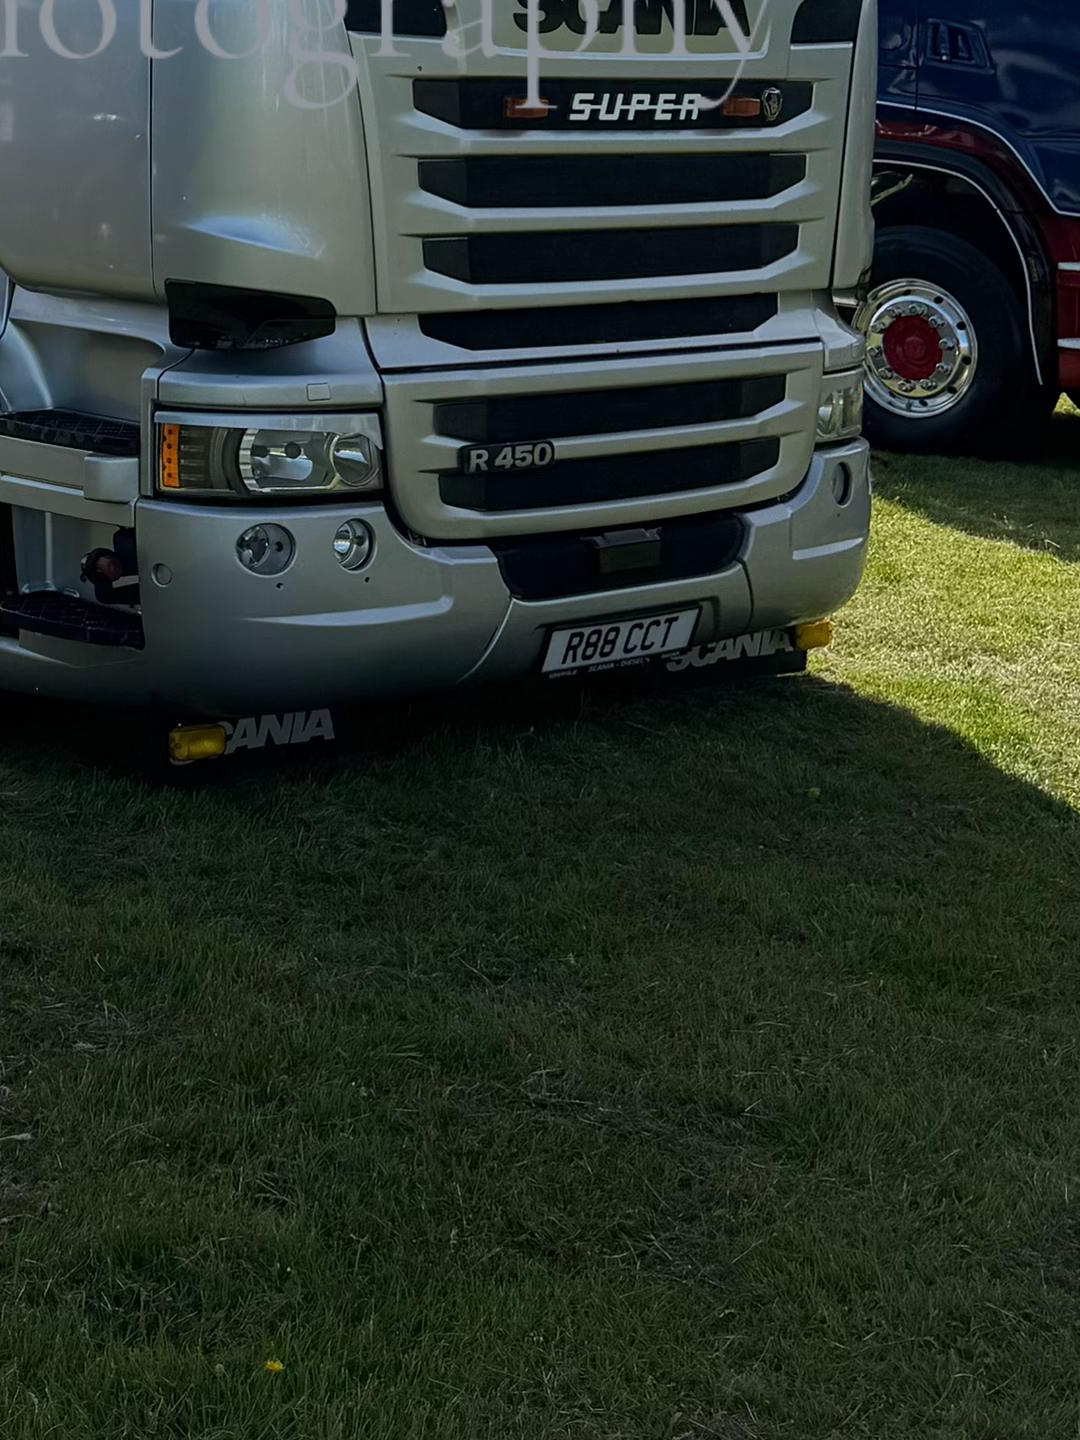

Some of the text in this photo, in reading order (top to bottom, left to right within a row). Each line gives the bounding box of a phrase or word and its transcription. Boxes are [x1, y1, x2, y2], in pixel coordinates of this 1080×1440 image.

[569, 93, 703, 121] SUPER
[468, 442, 553, 473] R 450
[561, 615, 680, 665] R88 CCT
